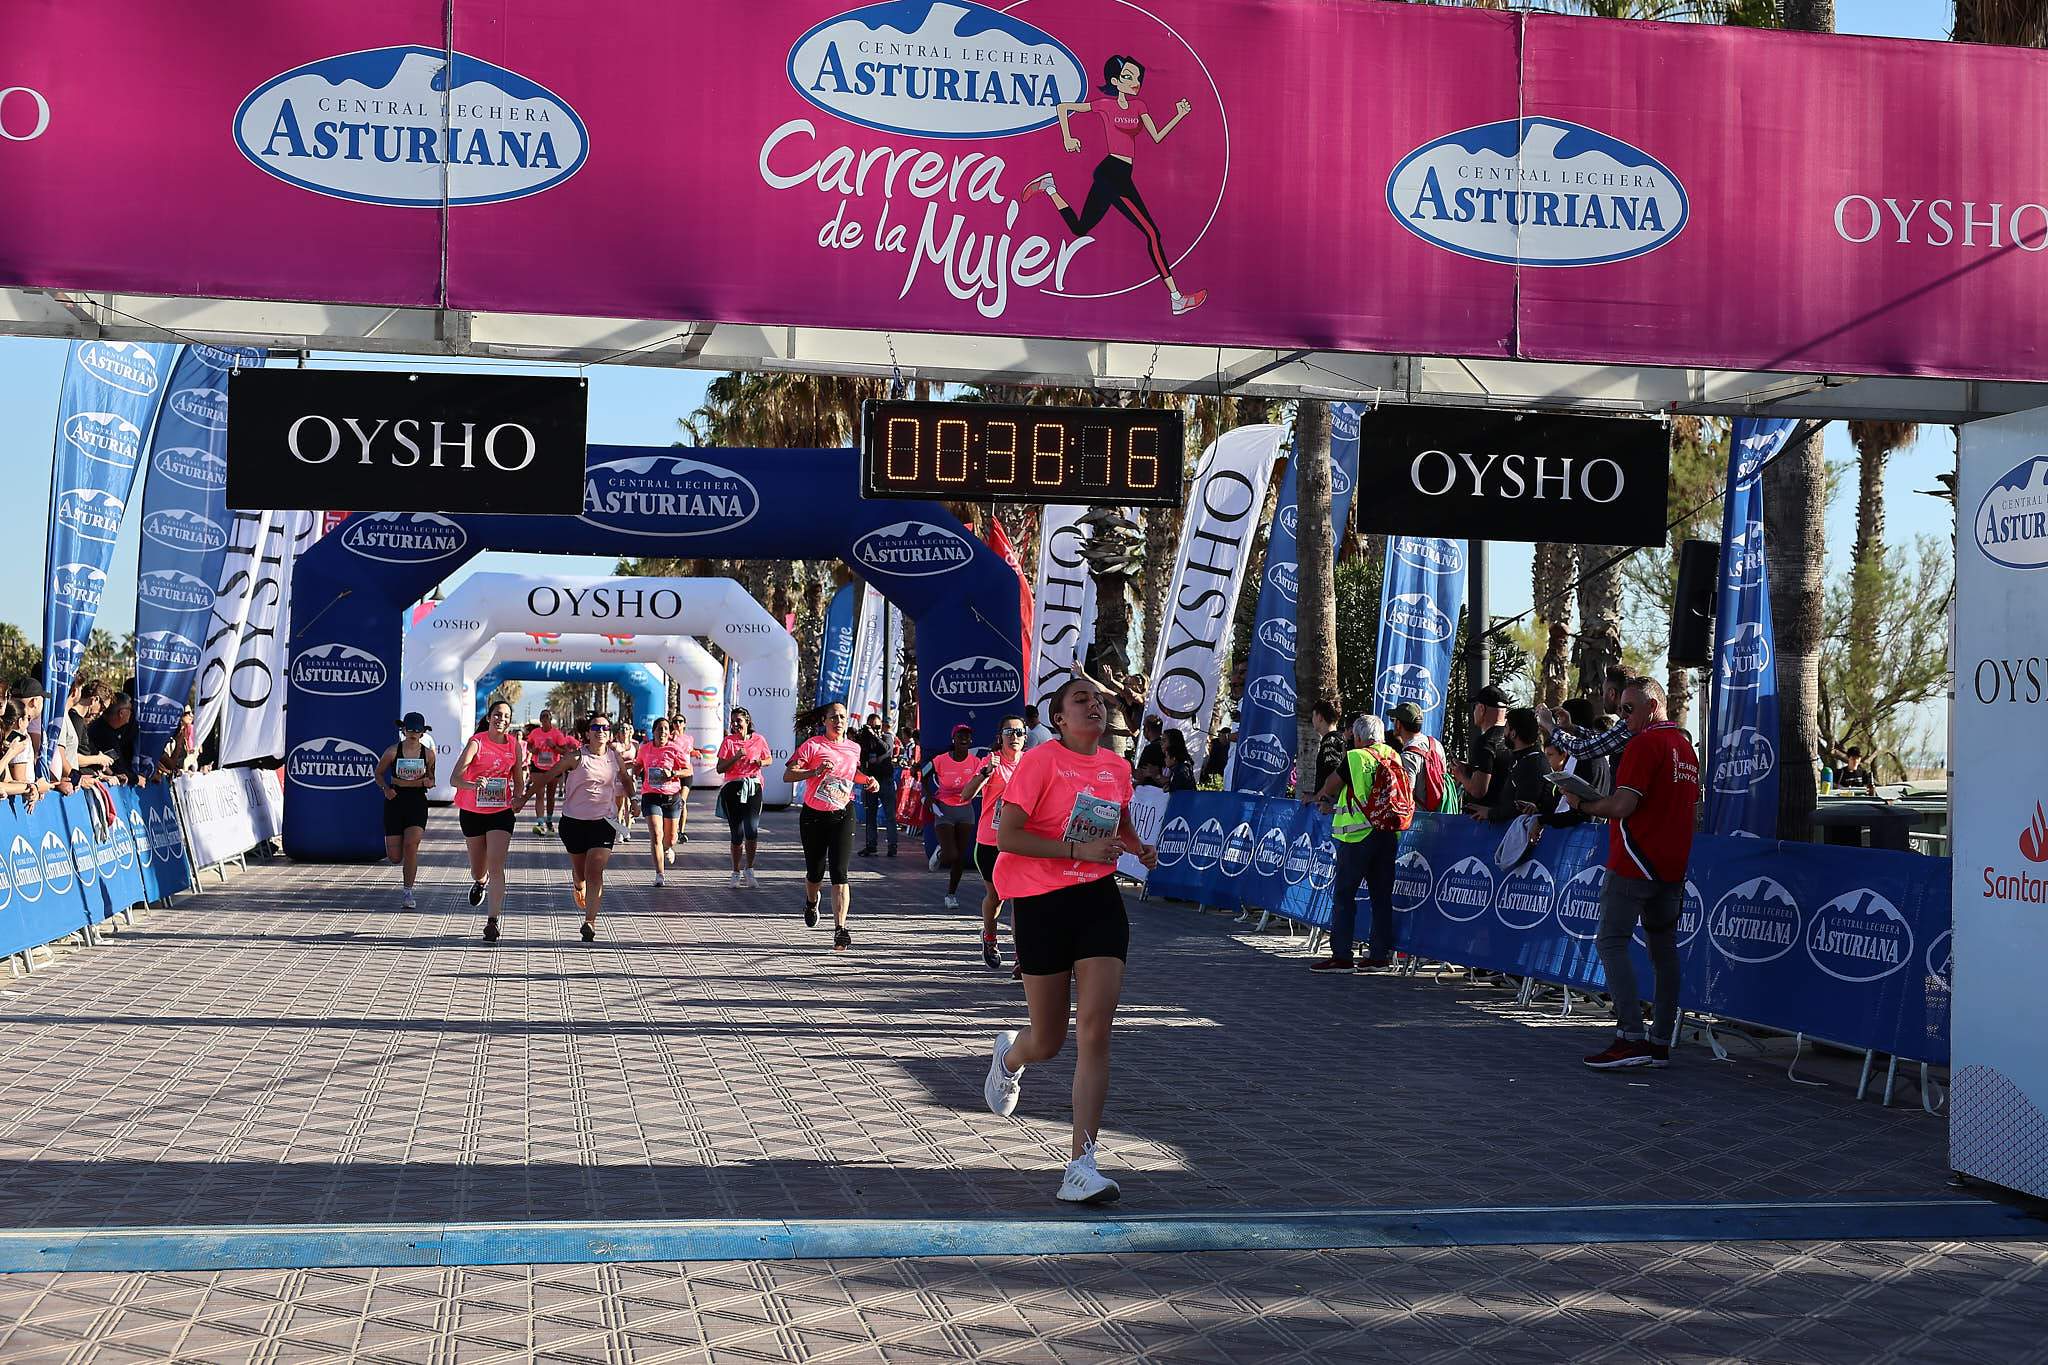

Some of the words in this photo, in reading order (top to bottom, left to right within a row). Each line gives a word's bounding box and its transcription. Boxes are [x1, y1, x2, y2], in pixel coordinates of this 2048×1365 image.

[858, 39, 953, 60] CENTRAL
[962, 48, 1056, 66] LECHERA
[811, 41, 1062, 107] ASTURIANA
[318, 98, 428, 117] CENTRAL
[1114, 116, 1139, 126] OYSHO
[261, 98, 561, 169] ASTURIANA
[759, 119, 1007, 204] Carrera
[1458, 165, 1551, 183] CENTRAL
[1561, 171, 1656, 188] LECHERA
[1410, 166, 1665, 231] ASTURIANA
[1834, 194, 2048, 252] OYSHO
[818, 200, 864, 249] de
[874, 200, 907, 252] la
[899, 200, 1095, 318] Mujer
[288, 415, 536, 471] OYSHO
[887, 417, 1159, 488] 00:38:16
[608, 478, 671, 489] CENTRAL
[676, 481, 739, 491] LECHERA
[1411, 450, 1625, 503] OYSHO
[584, 478, 745, 518] ASTURIANA
[2001, 496, 2043, 511] CENTRAL
[148, 516, 221, 547] ASTURIANA
[348, 526, 457, 550] ASTURIANA
[370, 524, 409, 533] CENTRAL
[415, 526, 456, 534] LECHERA
[1983, 504, 2048, 546] ASTUR
[863, 542, 967, 563] ASTURIANA
[879, 539, 919, 547] CENTRAL
[527, 586, 682, 620] OYSHO
[1155, 469, 1255, 720] OYSHO
[433, 619, 480, 631] OYSHO
[725, 622, 771, 634] OYSHO
[139, 647, 198, 666] STURIANA
[306, 660, 340, 668] CENTRAL
[343, 661, 378, 669] LECHERA
[826, 626, 853, 695] Marlene
[294, 661, 381, 684] ASTURIANA
[936, 675, 1017, 695] ASTURIANA
[1975, 656, 2048, 704] OYS
[409, 681, 455, 693] OYSHO
[748, 686, 791, 698] OYSHO
[290, 754, 376, 777] ASTURIANA
[1437, 878, 1488, 907] ASTURIANA
[1498, 883, 1549, 913] ASTURIANA
[1983, 866, 2048, 903] Santa
[1732, 903, 1761, 915] CENTRAL
[1713, 904, 1791, 945] ASTURIANA
[1831, 916, 1864, 931] CENTRAL
[1868, 921, 1901, 935] LECHERA
[1811, 916, 1900, 964] ASTURIANA
